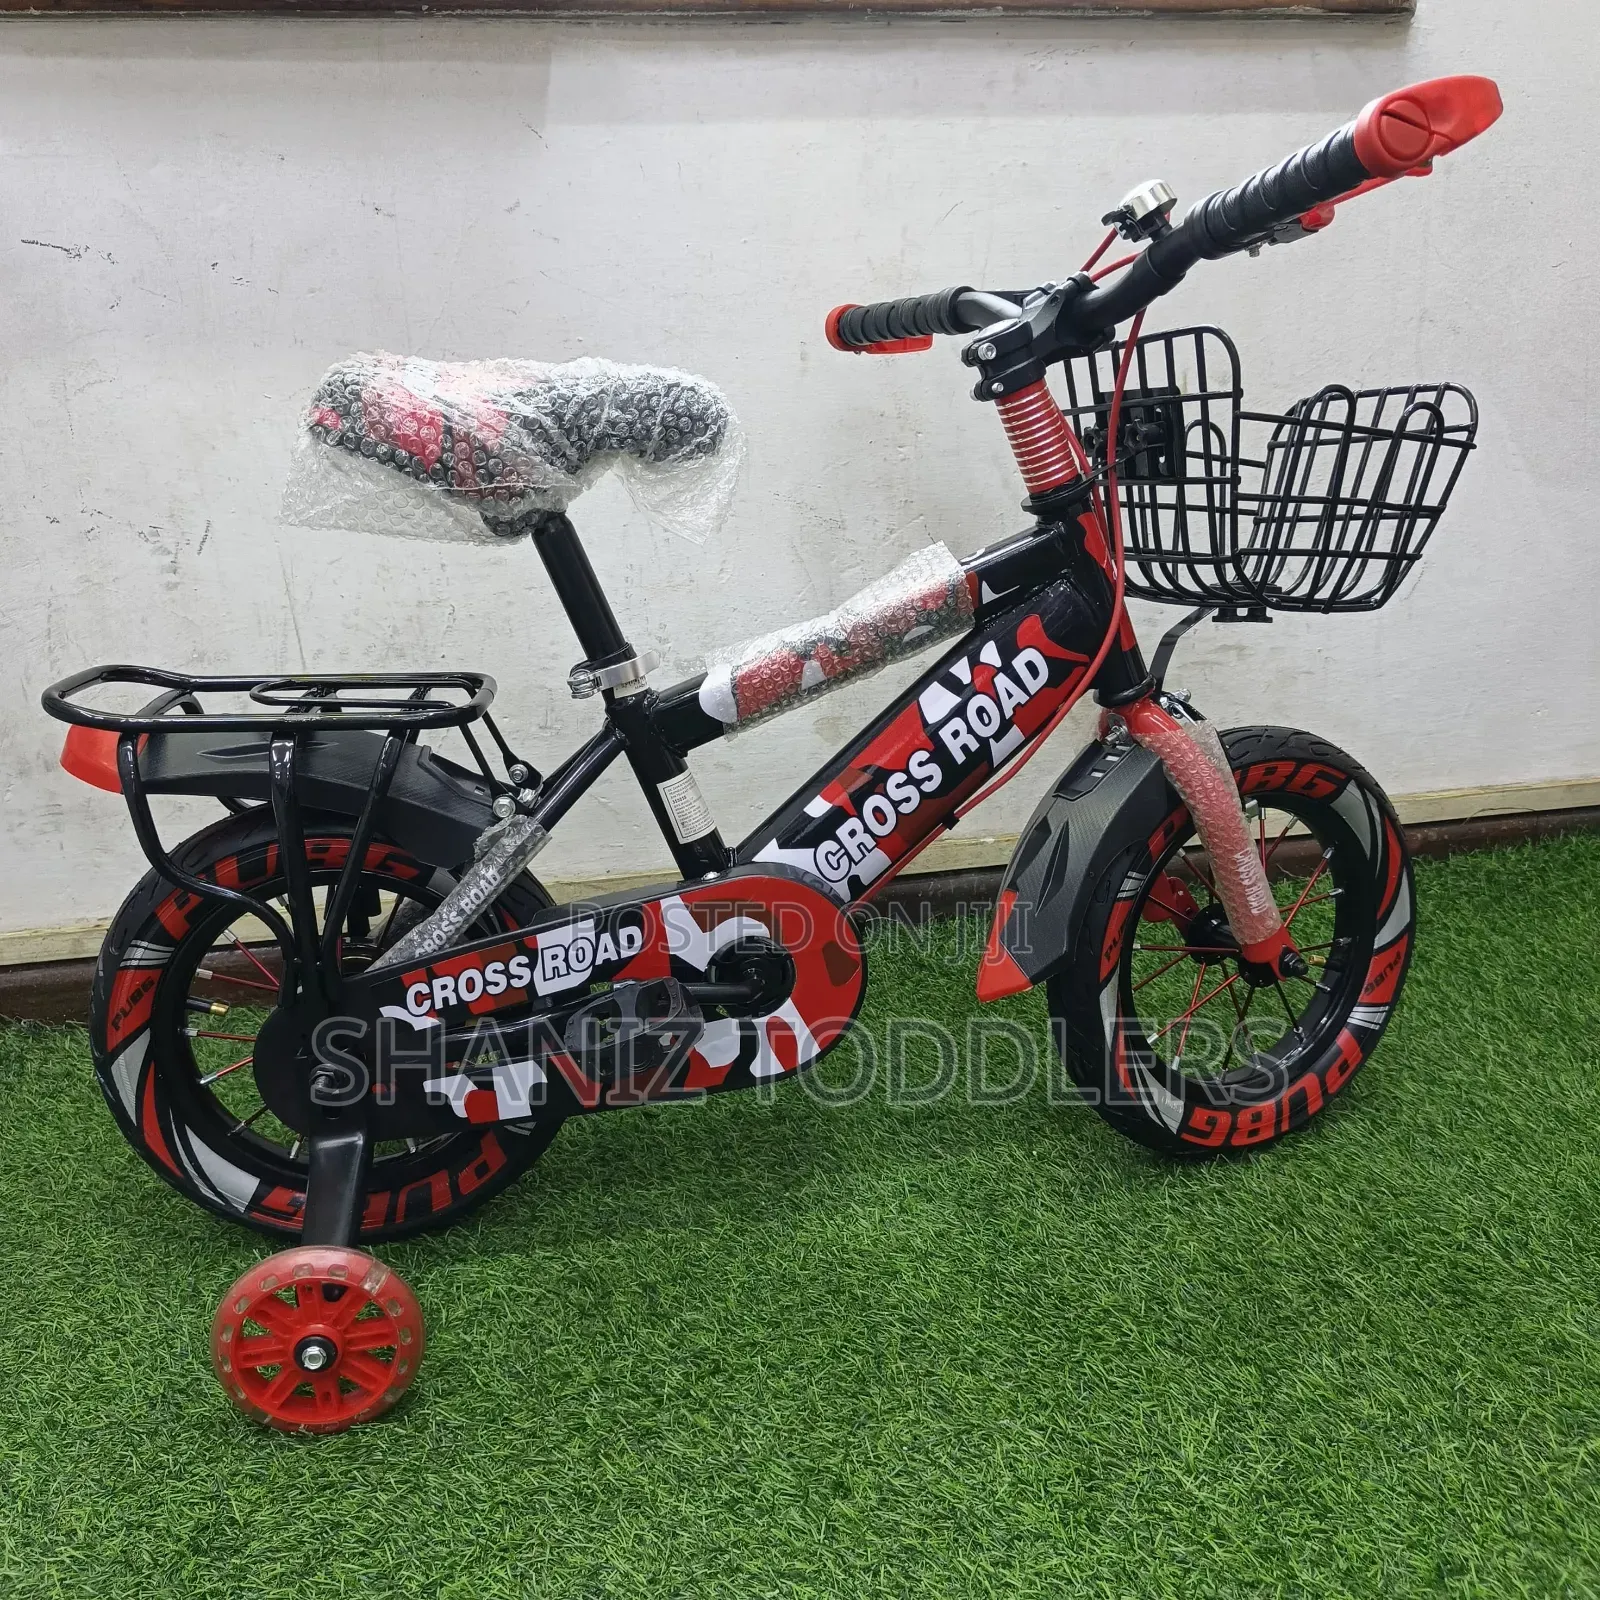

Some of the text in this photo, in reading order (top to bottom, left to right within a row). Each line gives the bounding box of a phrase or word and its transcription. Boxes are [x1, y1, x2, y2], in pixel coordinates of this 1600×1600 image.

[813, 749, 943, 884] CROSS
[938, 647, 1049, 765] ROAD
[460, 866, 500, 915] ROAD
[406, 924, 644, 1018] CROSS ROAD
[1180, 1028, 1364, 1148] PUBG
